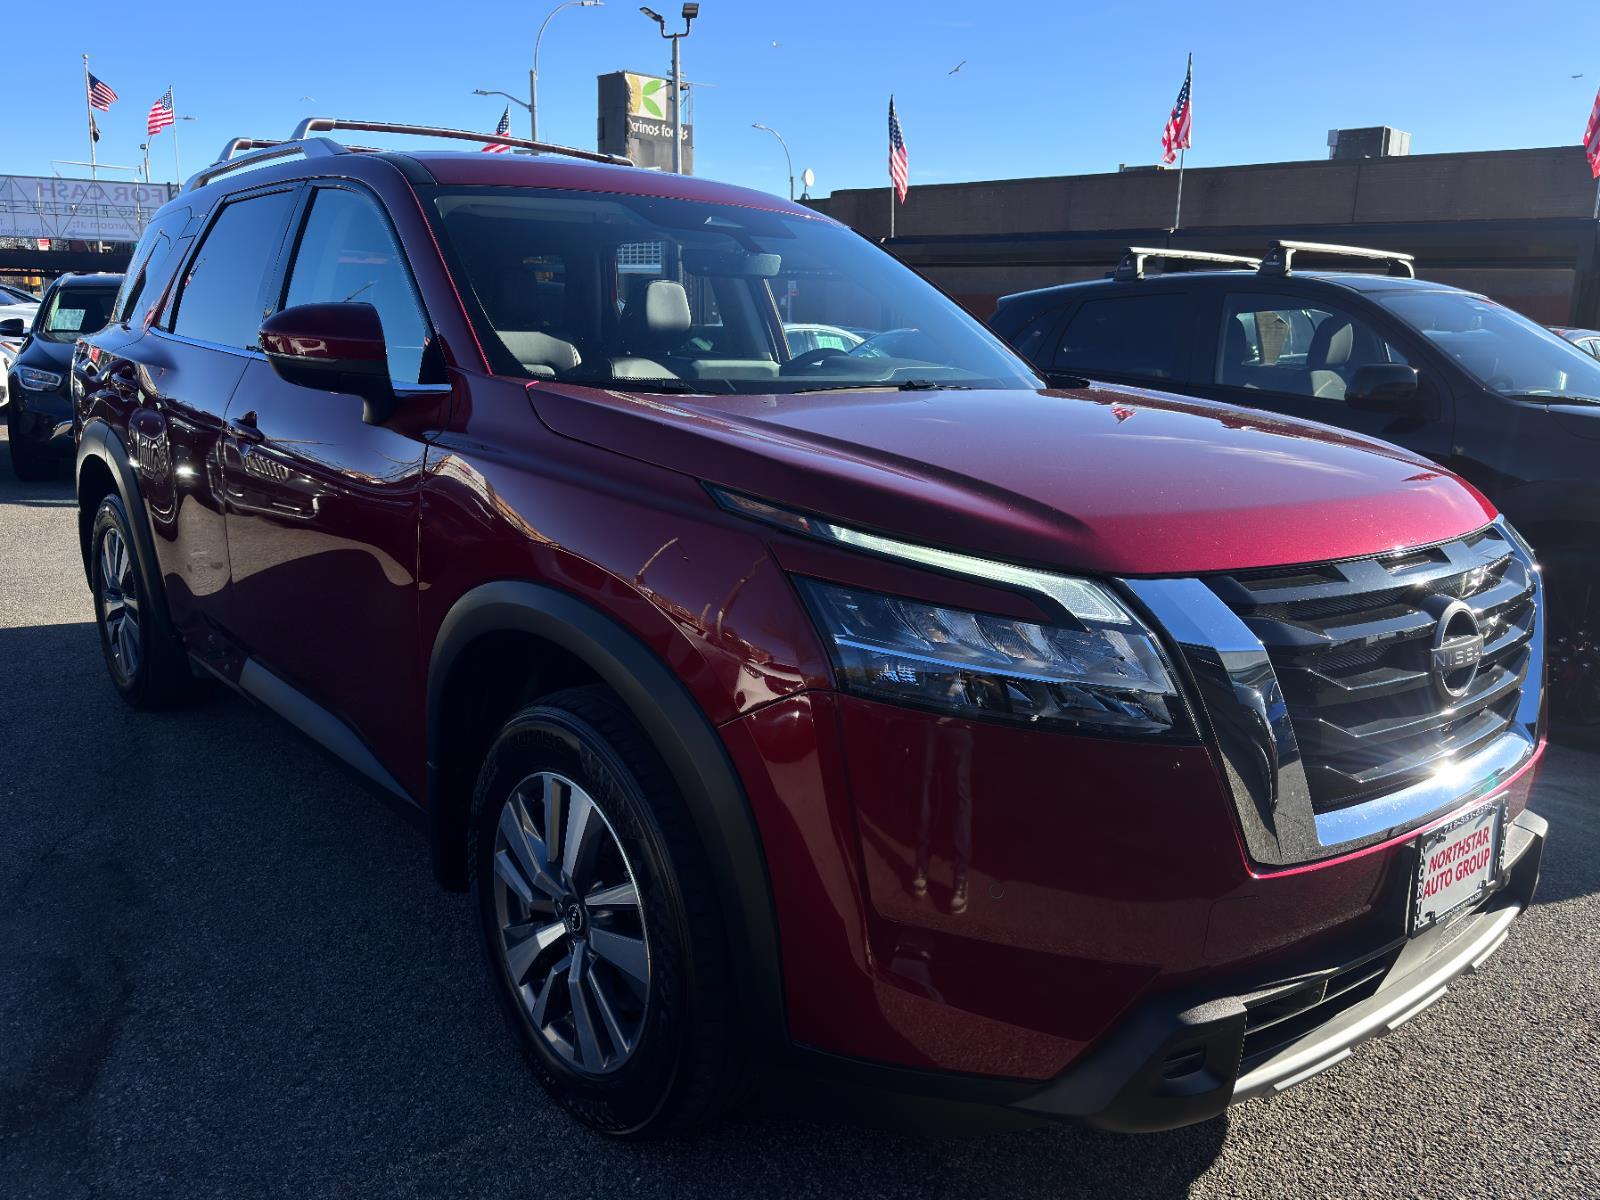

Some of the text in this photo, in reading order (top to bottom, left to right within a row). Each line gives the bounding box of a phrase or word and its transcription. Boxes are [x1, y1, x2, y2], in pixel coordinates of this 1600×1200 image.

[661, 124, 689, 141] fos
[1422, 847, 1490, 901] AUTO GROUP
[1429, 826, 1490, 875] NORTHSTAR
[1413, 847, 1425, 932] NORTH
